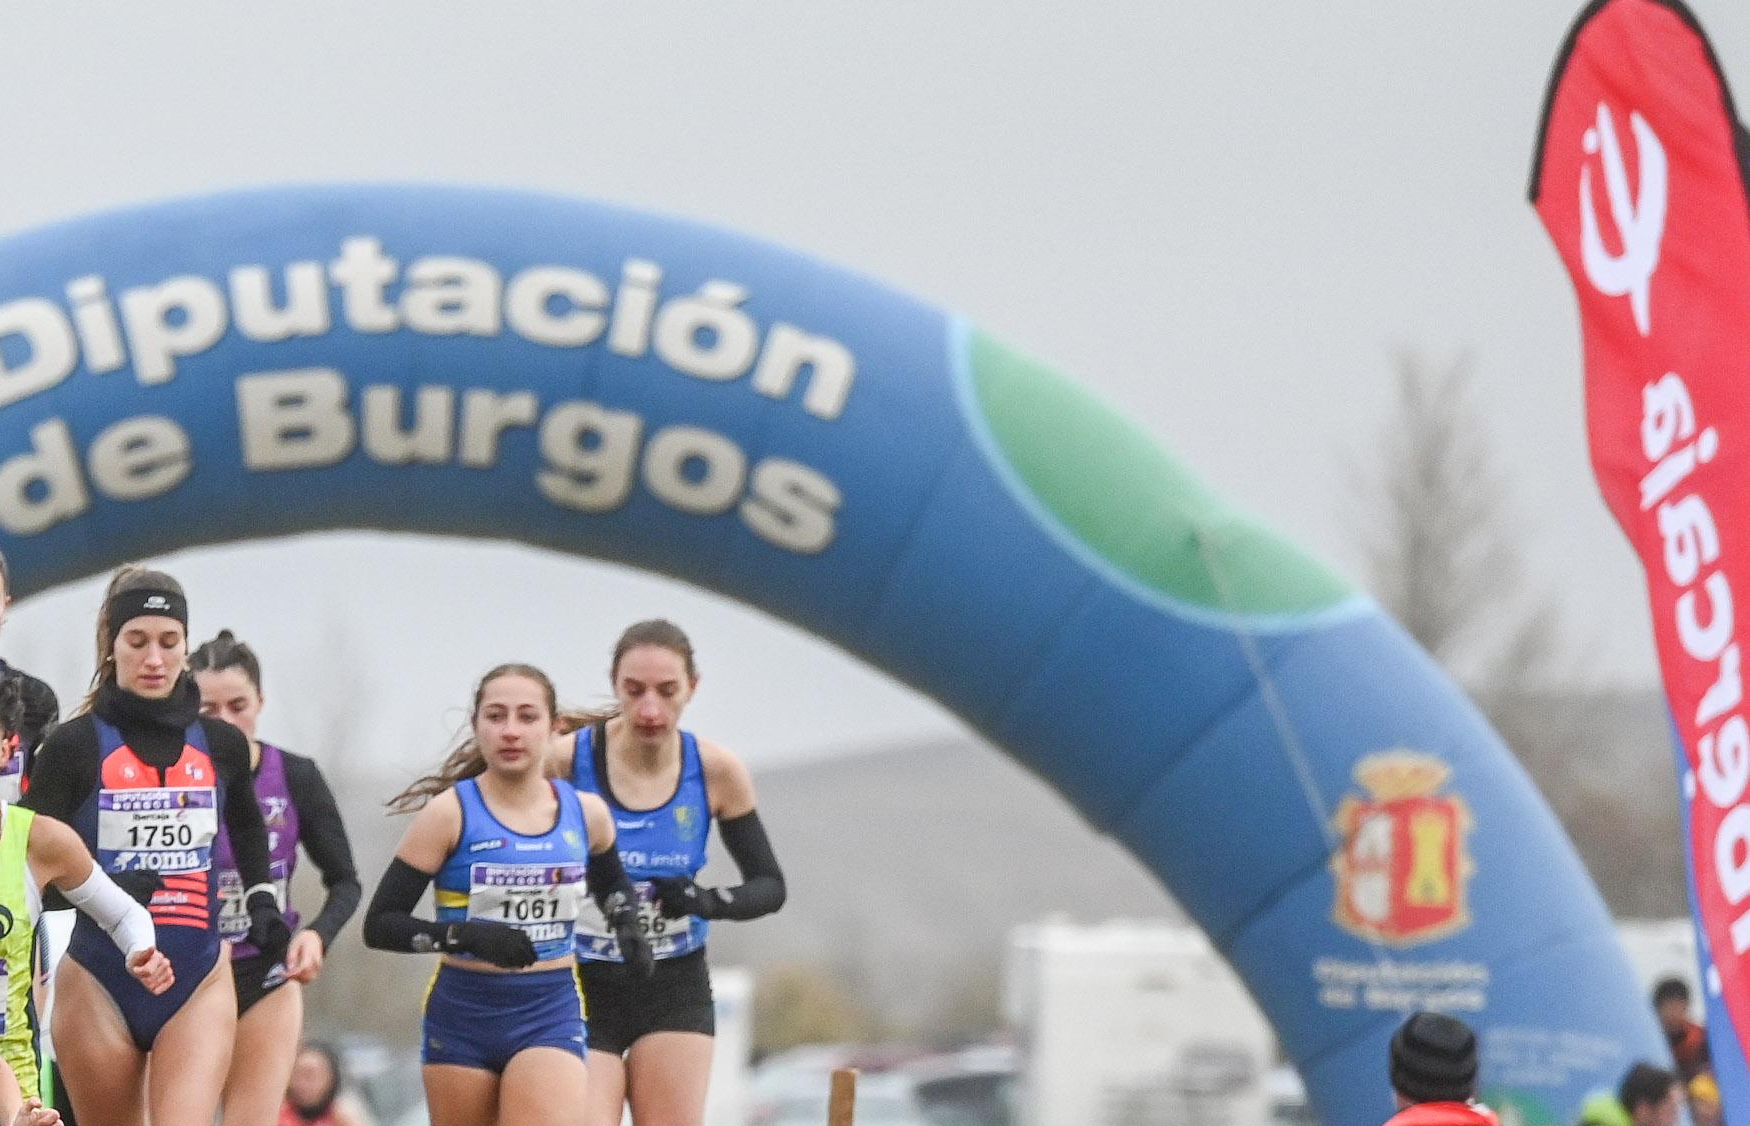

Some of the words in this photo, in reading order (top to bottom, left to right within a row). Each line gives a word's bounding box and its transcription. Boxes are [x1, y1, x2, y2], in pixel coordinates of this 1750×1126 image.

[234, 366, 842, 554] Burgos
[127, 824, 192, 847] 1750
[501, 899, 559, 919] 1061
